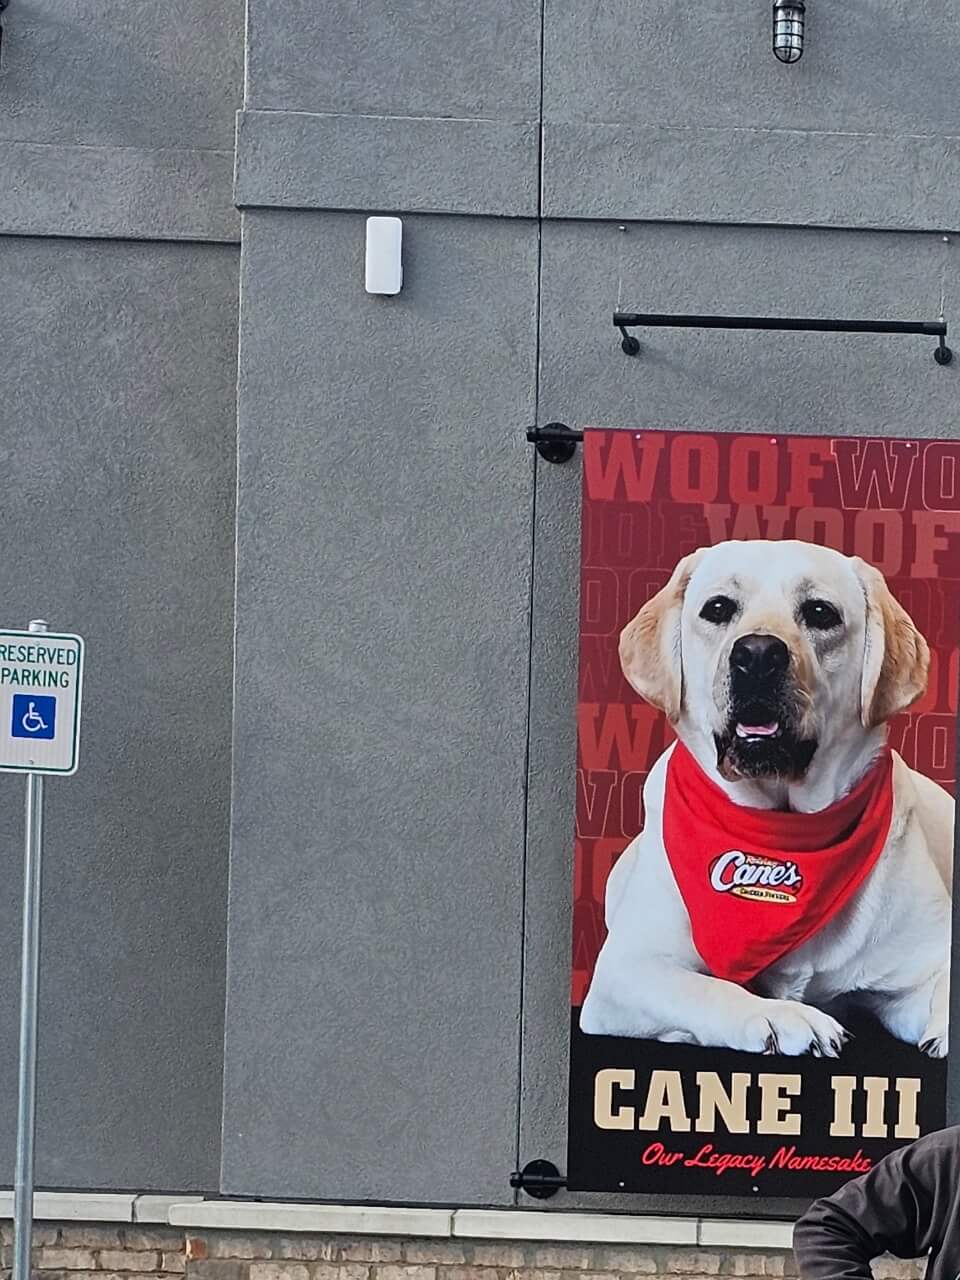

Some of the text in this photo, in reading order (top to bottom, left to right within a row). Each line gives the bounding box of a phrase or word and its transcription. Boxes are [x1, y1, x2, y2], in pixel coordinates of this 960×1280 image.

[584, 431, 833, 507] WOOF
[0, 644, 77, 666] RESERVED
[1, 667, 70, 689] PARKING
[711, 850, 802, 892] Cane's
[594, 1068, 922, 1139] CANE III
[642, 1142, 872, 1177] Our Legacy Namesake
